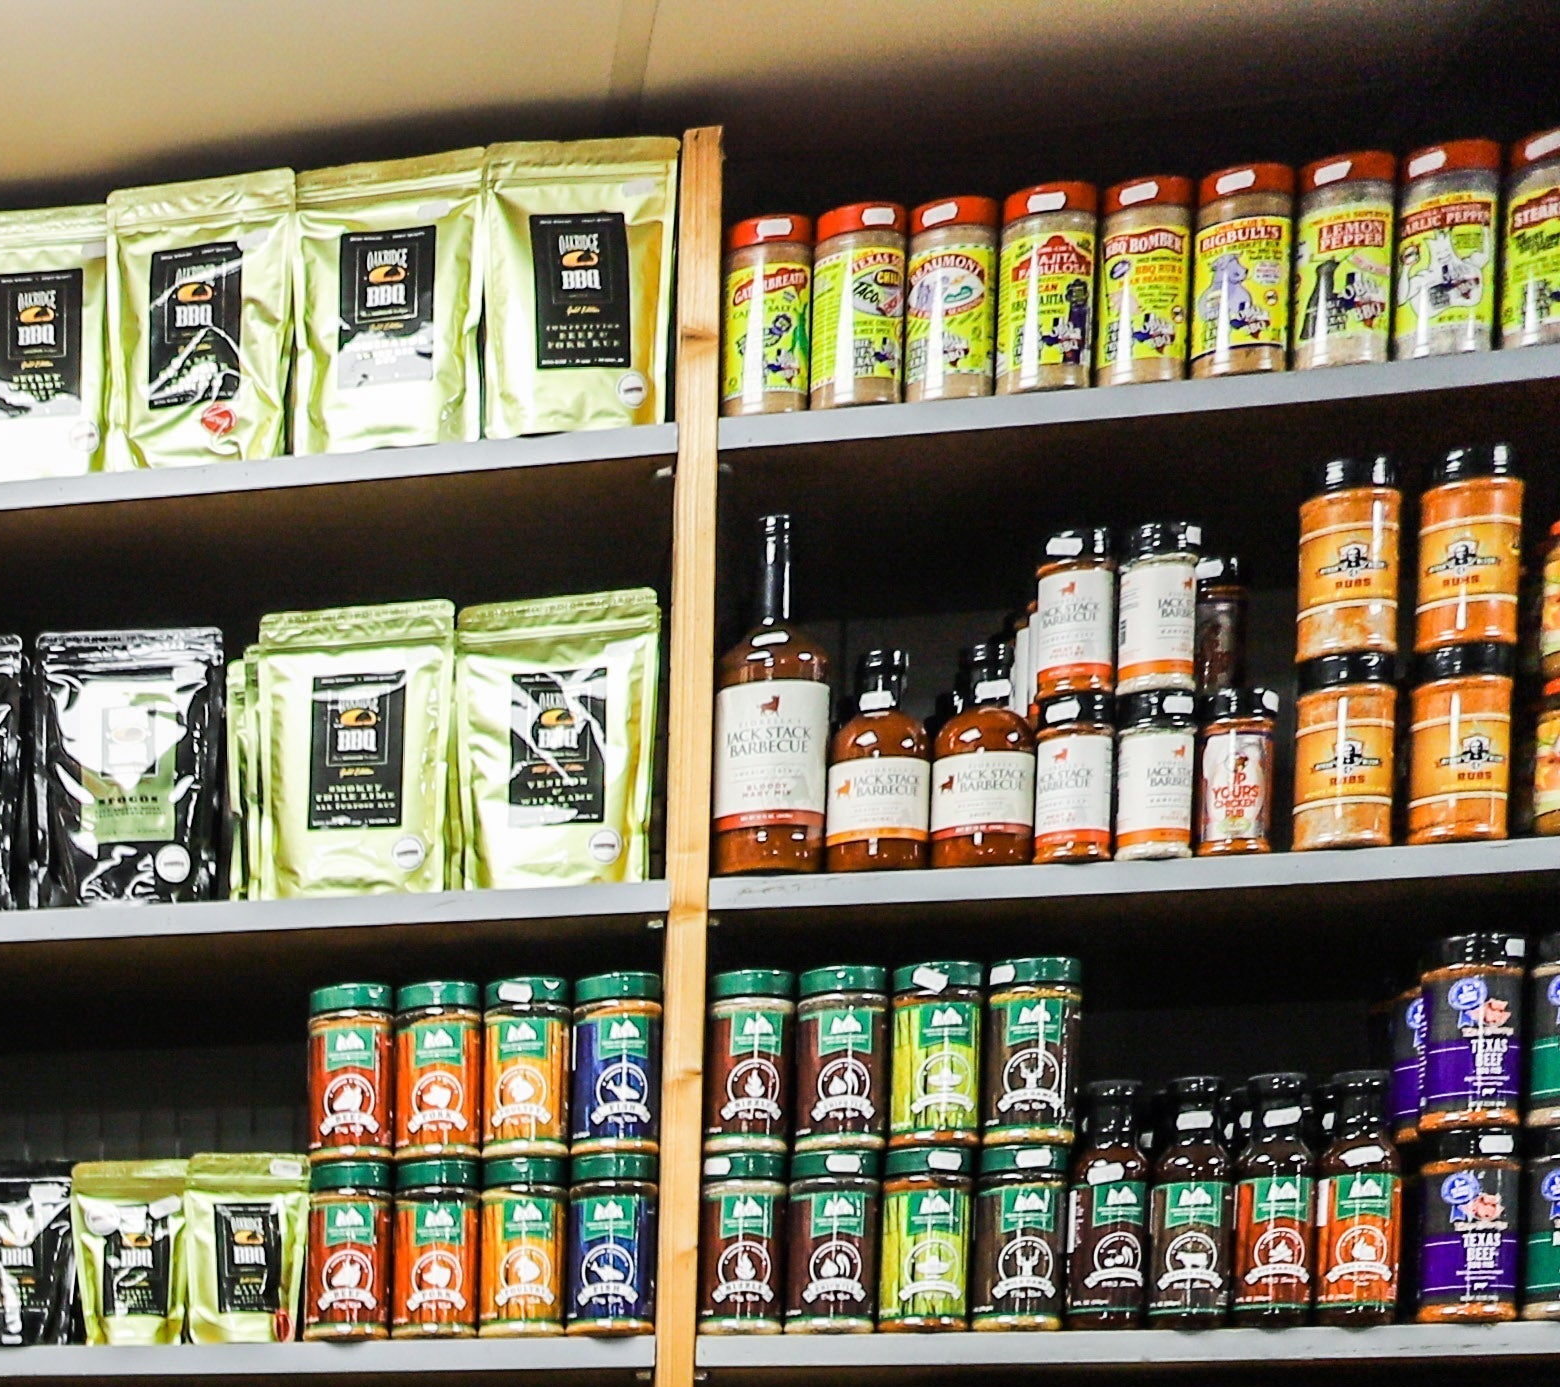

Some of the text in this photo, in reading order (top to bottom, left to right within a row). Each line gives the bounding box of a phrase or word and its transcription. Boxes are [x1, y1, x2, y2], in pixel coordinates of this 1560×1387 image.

[1322, 221, 1383, 238] LEMON
[559, 233, 599, 253] OAKRIDGE
[1130, 233, 1182, 253] BOMBER
[1200, 225, 1280, 252] BIGBULL'S
[1320, 233, 1384, 252] PEPPER
[367, 248, 408, 269] OAKRIDGE
[909, 255, 984, 284] BEAUMONT
[561, 270, 602, 291] BBQ
[17, 290, 56, 311] OAKRIDGE
[366, 283, 406, 307] BBQ
[174, 303, 210, 327] BBQ
[17, 325, 55, 347] BBQ
[337, 728, 378, 752] BBQ
[726, 727, 811, 744] JACK STACK
[729, 741, 808, 757] BARBECUE
[854, 775, 920, 788] JACK STACK
[957, 769, 1025, 782] JACK STACK
[1457, 771, 1492, 781] RUBS
[856, 785, 920, 798] BARBECUE
[959, 780, 1025, 793] BARBECUE
[1212, 786, 1259, 799] YOURS
[1214, 799, 1258, 811] CHICKEN
[1471, 1037, 1509, 1054] TEXAS
[1475, 1052, 1505, 1067] BEEF
[1463, 1232, 1503, 1248] TEXAS
[1467, 1247, 1499, 1264] BEEF
